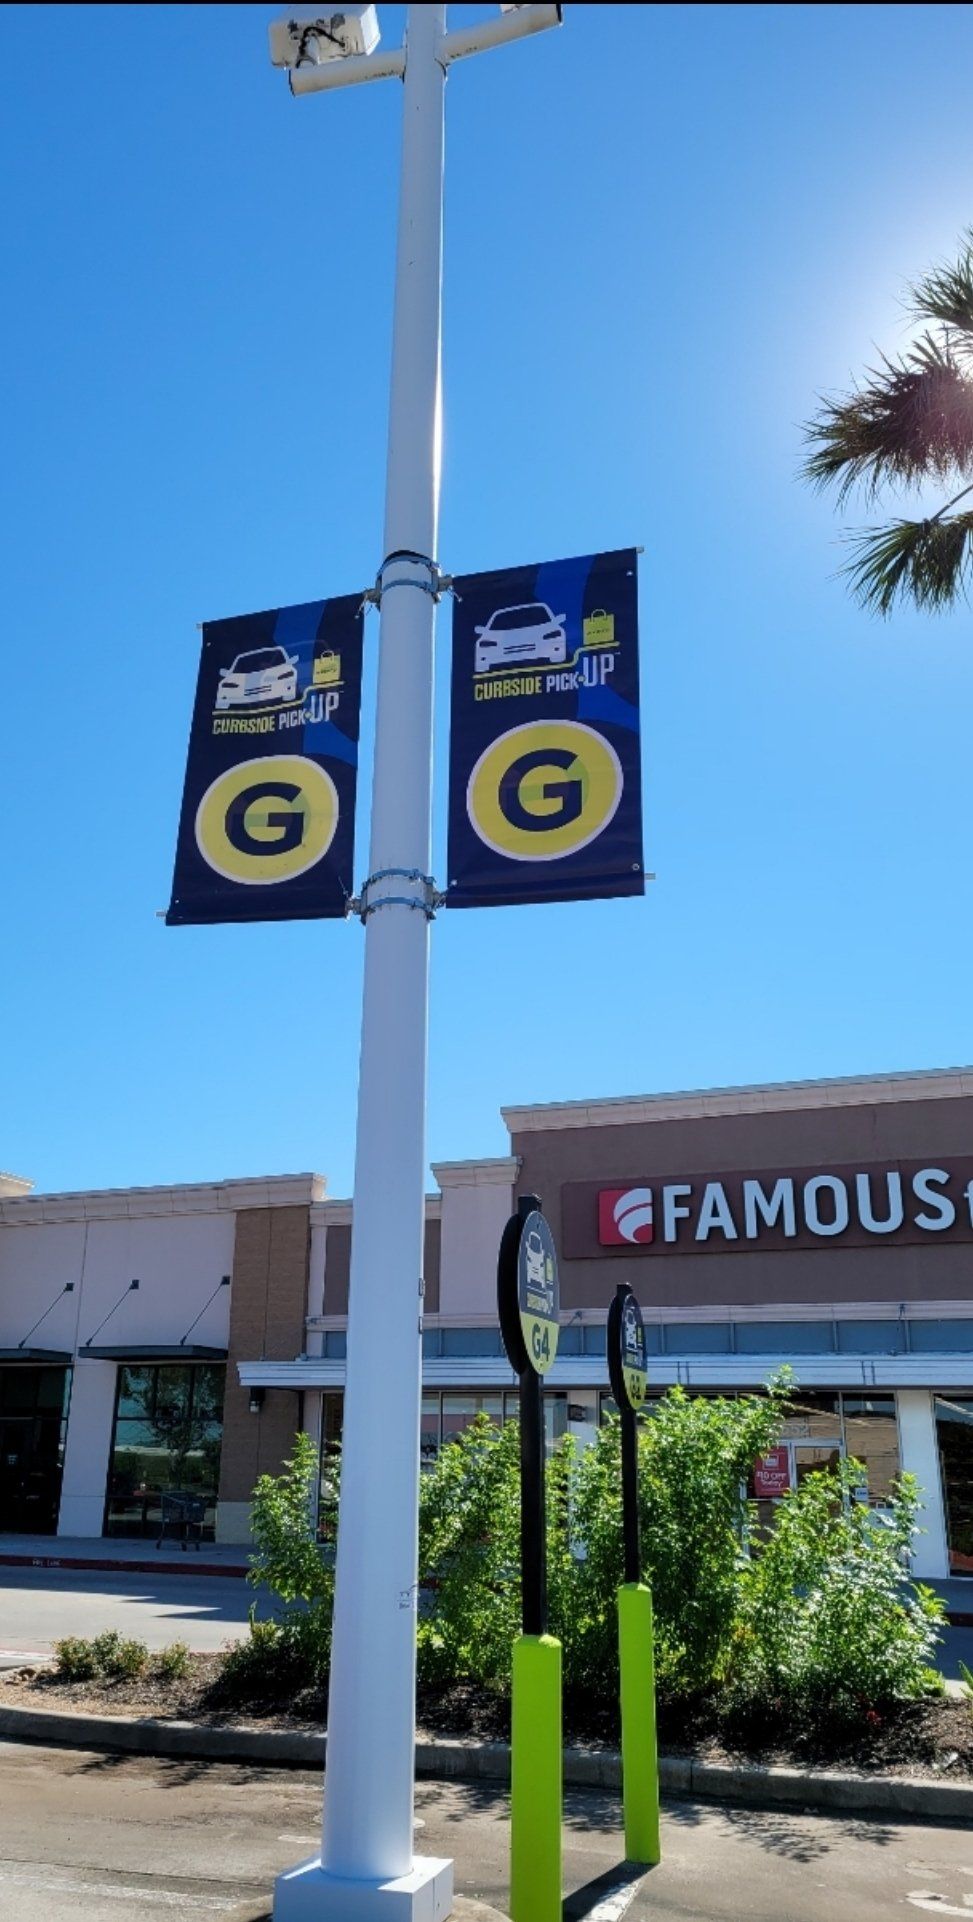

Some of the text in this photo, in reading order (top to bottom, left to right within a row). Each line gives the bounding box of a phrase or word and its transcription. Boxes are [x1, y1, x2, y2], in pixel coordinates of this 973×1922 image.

[475, 675, 542, 701] CURBSIDE
[212, 716, 275, 735] CURBSIDE
[498, 748, 583, 832] G
[225, 782, 304, 856] G
[662, 1168, 956, 1243] FAMOUS
[531, 1322, 551, 1362] G4
